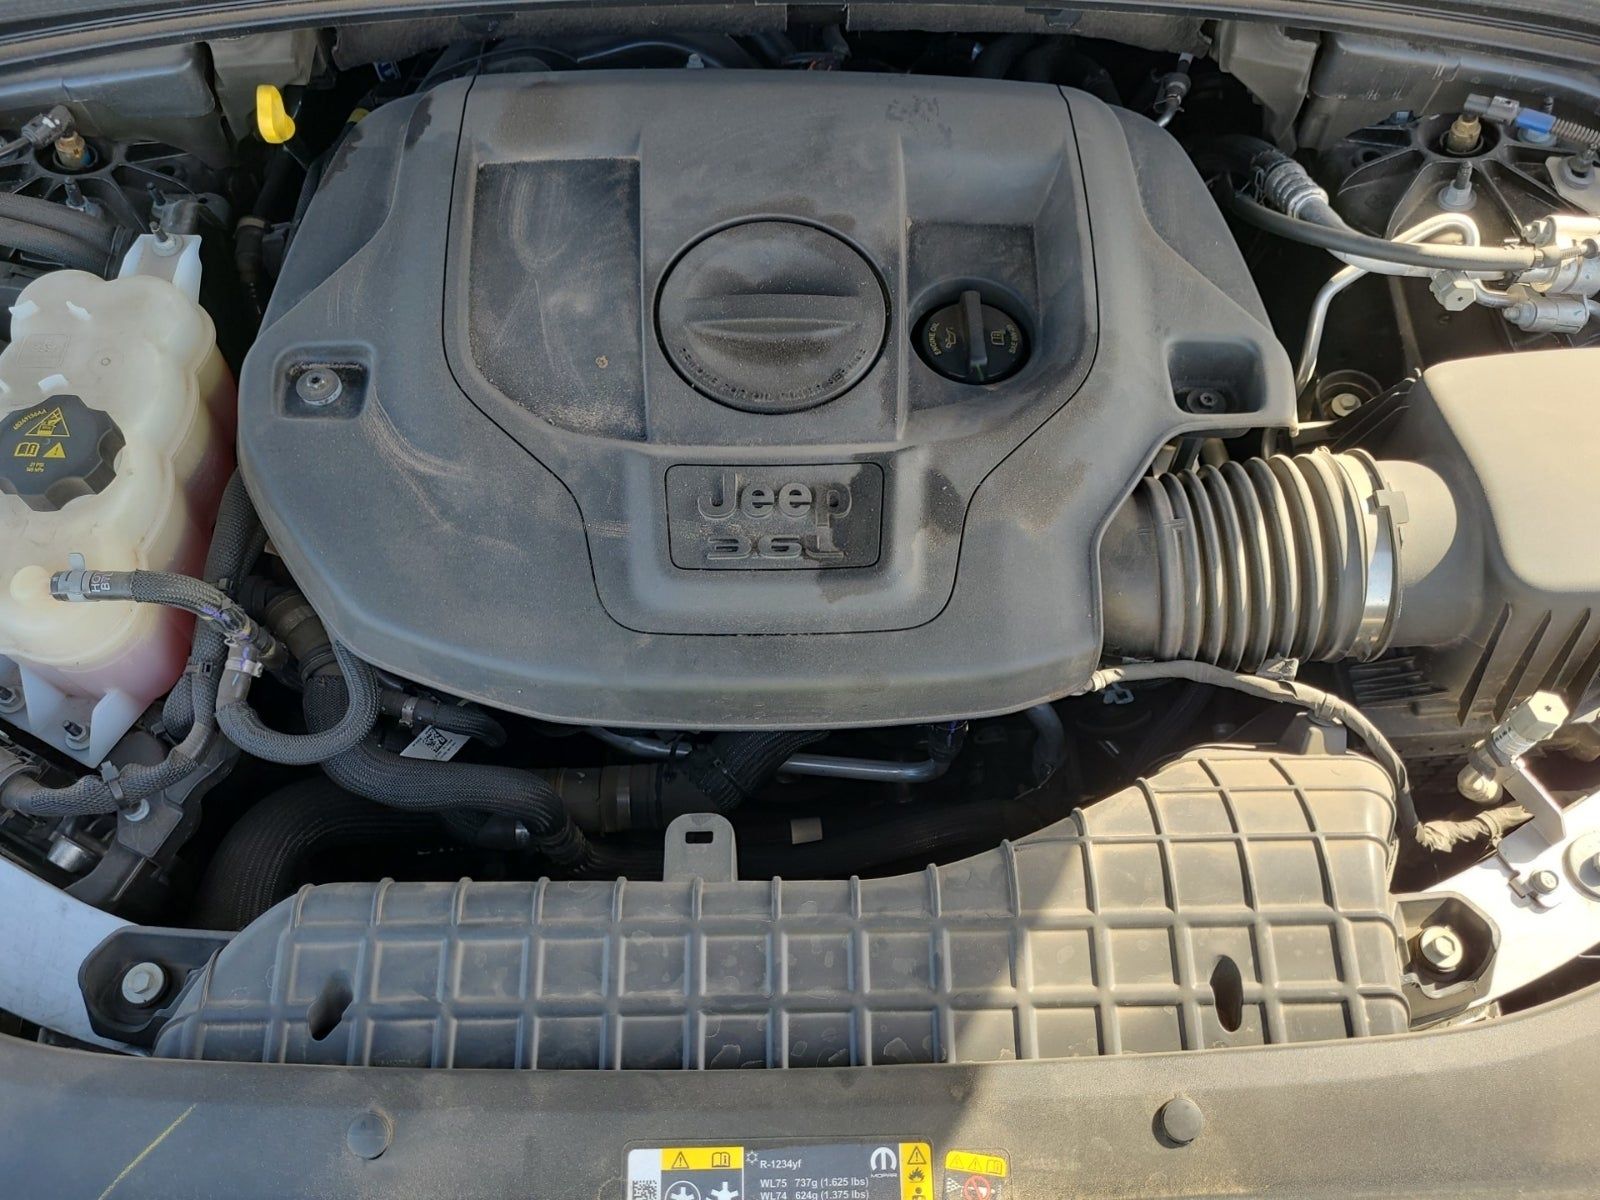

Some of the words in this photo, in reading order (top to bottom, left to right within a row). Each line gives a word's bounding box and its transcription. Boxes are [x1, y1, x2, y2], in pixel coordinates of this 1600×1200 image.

[698, 473, 852, 528] Jeep
[760, 1158, 802, 1171] R-1234yf
[760, 1178, 787, 1189] WL75
[795, 1178, 818, 1189] 737g
[820, 1177, 849, 1188] (1.625
[851, 1176, 869, 1187] lbs)
[760, 1191, 787, 1200] WL74
[795, 1191, 818, 1200] 624g
[820, 1190, 849, 1200] (1.375
[851, 1189, 869, 1200] lbs)
